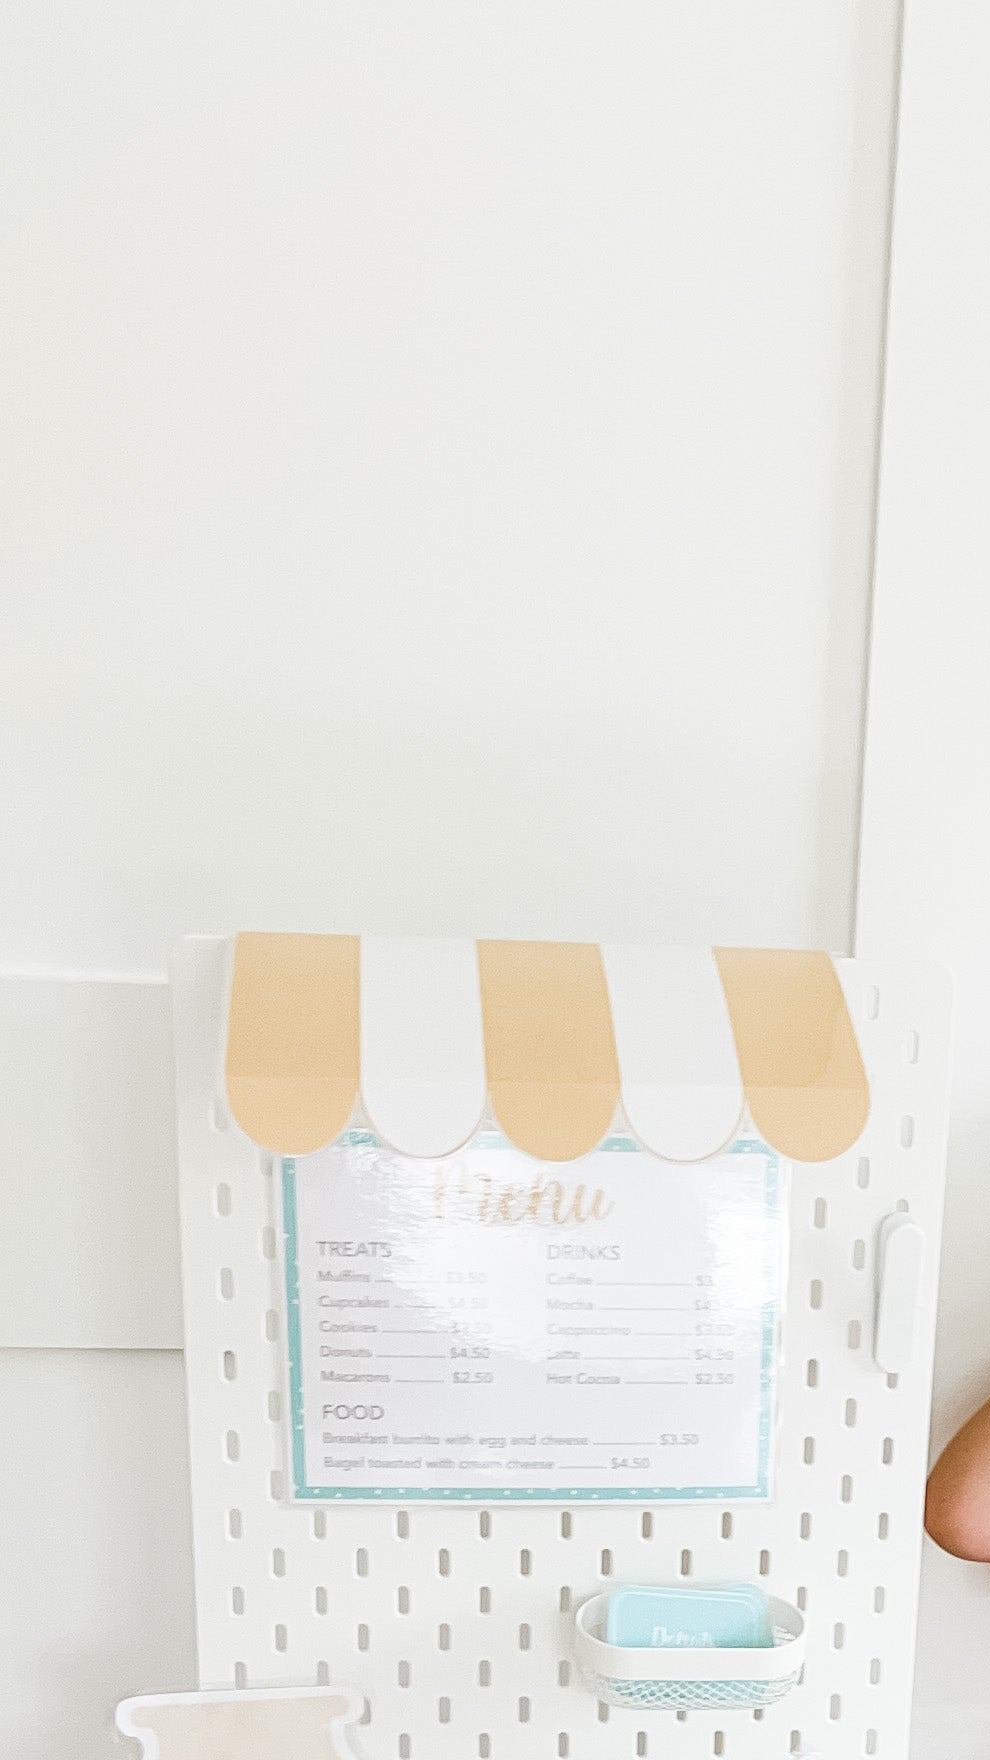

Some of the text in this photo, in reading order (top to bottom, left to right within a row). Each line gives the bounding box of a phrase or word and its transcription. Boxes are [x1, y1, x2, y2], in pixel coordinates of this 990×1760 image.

[315, 1241, 391, 1257] TREATS
[546, 1244, 621, 1260] DRINKS
[318, 1320, 377, 1333] Cookies
[453, 1372, 494, 1383] $2.50
[547, 1373, 572, 1384] Hot
[694, 1373, 735, 1384] $2.50
[322, 1405, 385, 1420] FOOD
[445, 1434, 474, 1445] with
[479, 1437, 506, 1448] egg
[510, 1435, 536, 1445] and
[659, 1434, 699, 1446] $3.50
[611, 1457, 651, 1469] $4.50
